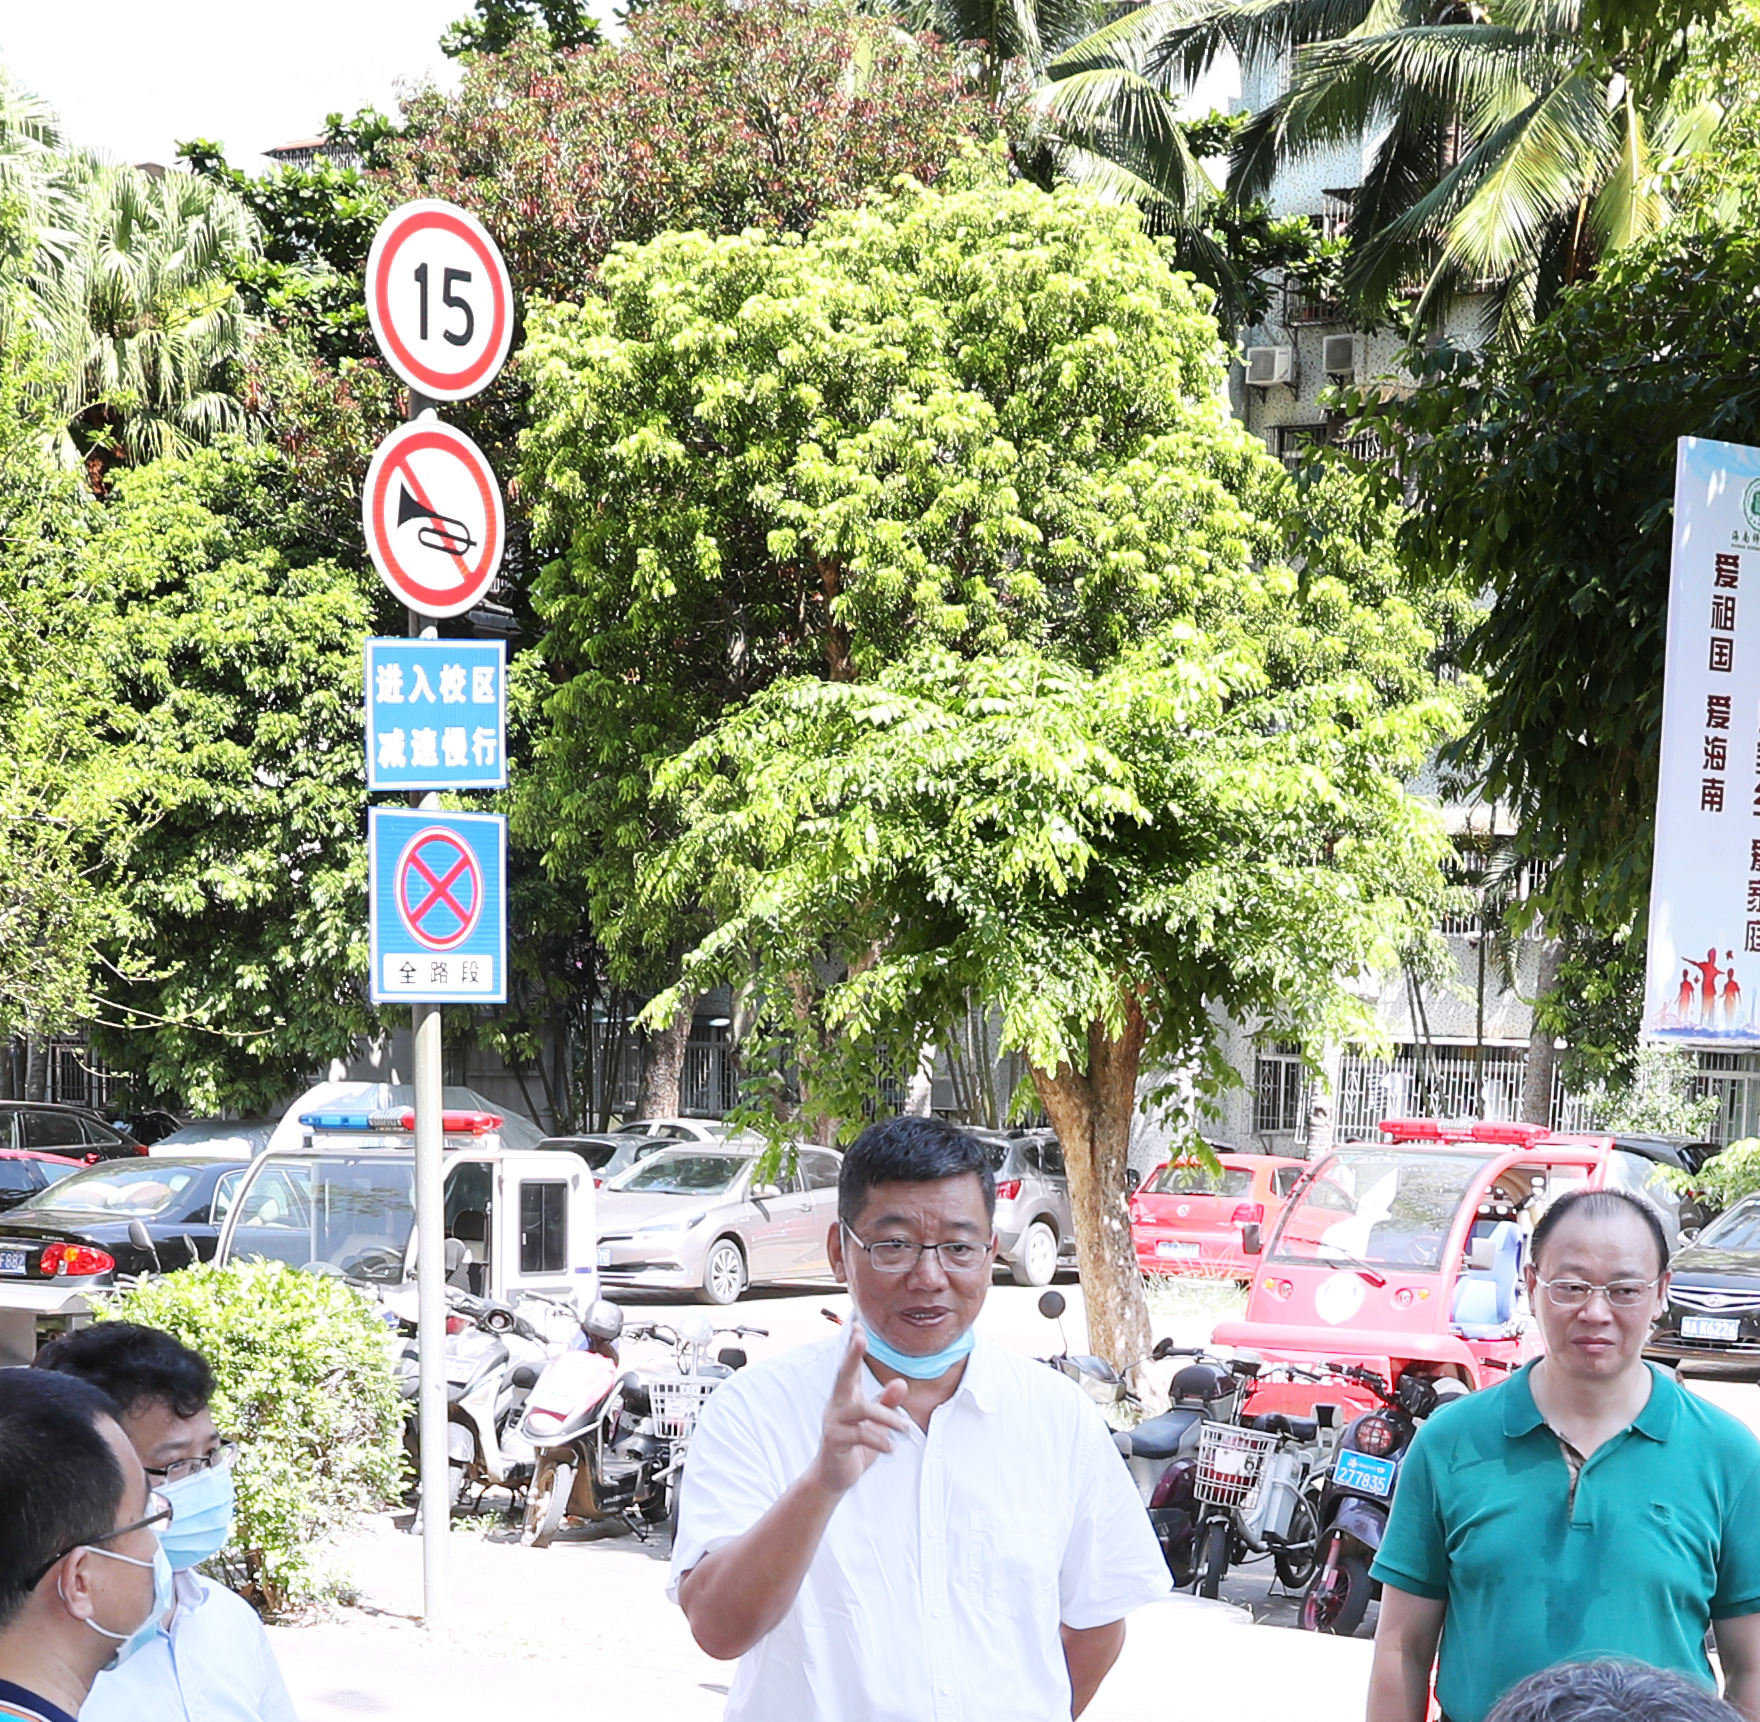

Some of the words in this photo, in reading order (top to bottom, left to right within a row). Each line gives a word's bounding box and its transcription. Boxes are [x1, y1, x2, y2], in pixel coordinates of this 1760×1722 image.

[414, 262, 474, 347] 15
[1709, 552, 1740, 674] 爱祖国
[375, 663, 496, 704] 进入校区
[378, 726, 498, 769] 减速慢行
[1701, 695, 1732, 814] 爱海南
[398, 960, 480, 985] 全路段
[1337, 1466, 1387, 1493] 277835
